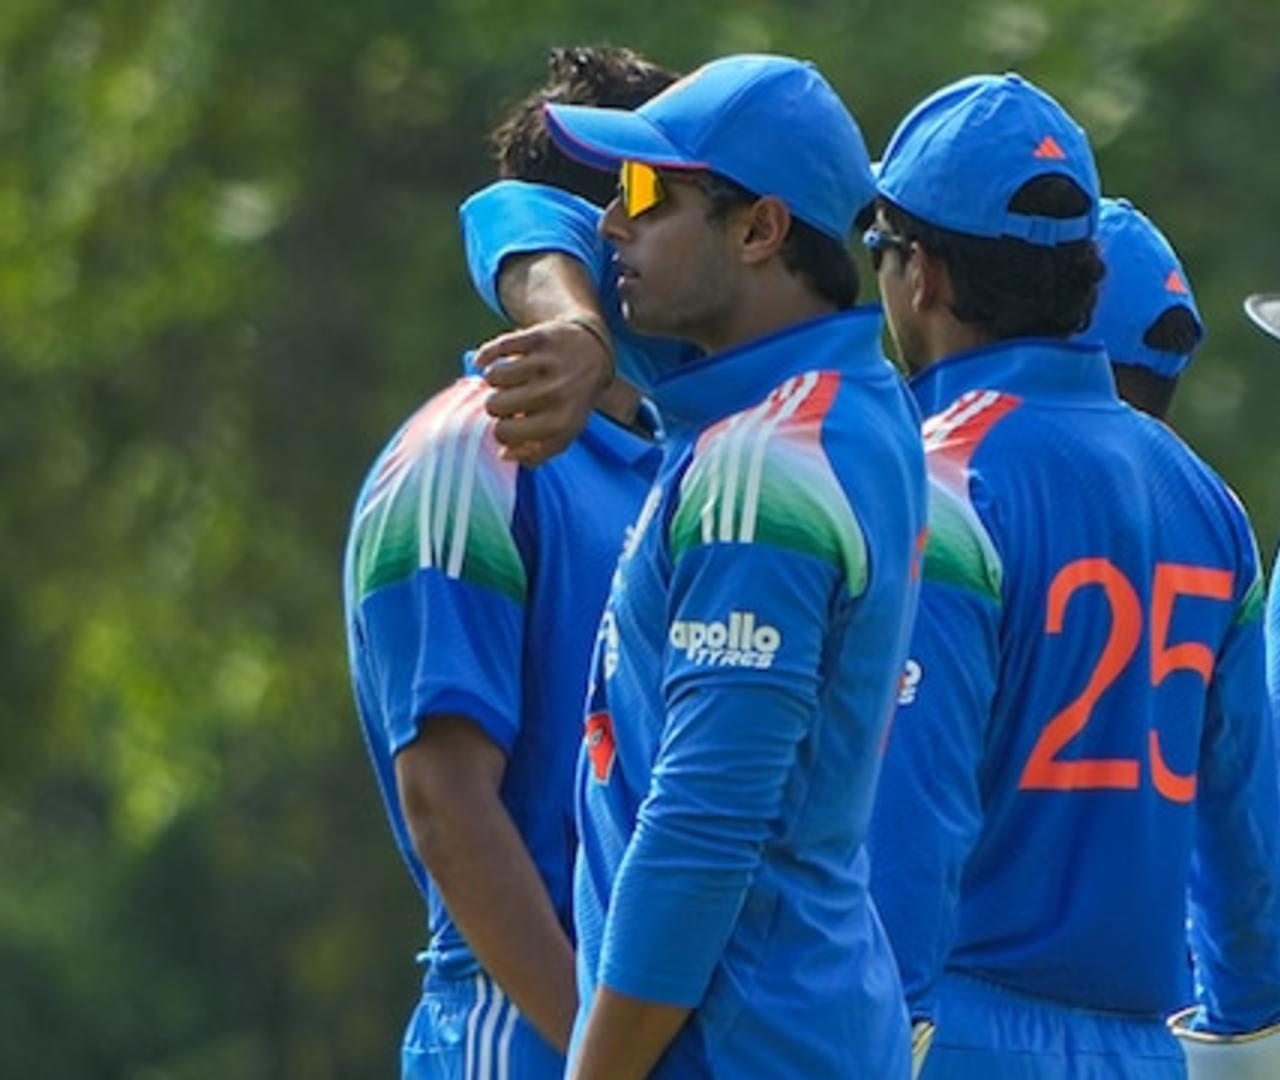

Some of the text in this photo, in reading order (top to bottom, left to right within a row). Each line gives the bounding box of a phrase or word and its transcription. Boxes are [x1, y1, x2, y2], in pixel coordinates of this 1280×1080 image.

[669, 611, 781, 661] apollo
[694, 647, 776, 669] TYRES
[1019, 557, 1234, 805] 25
